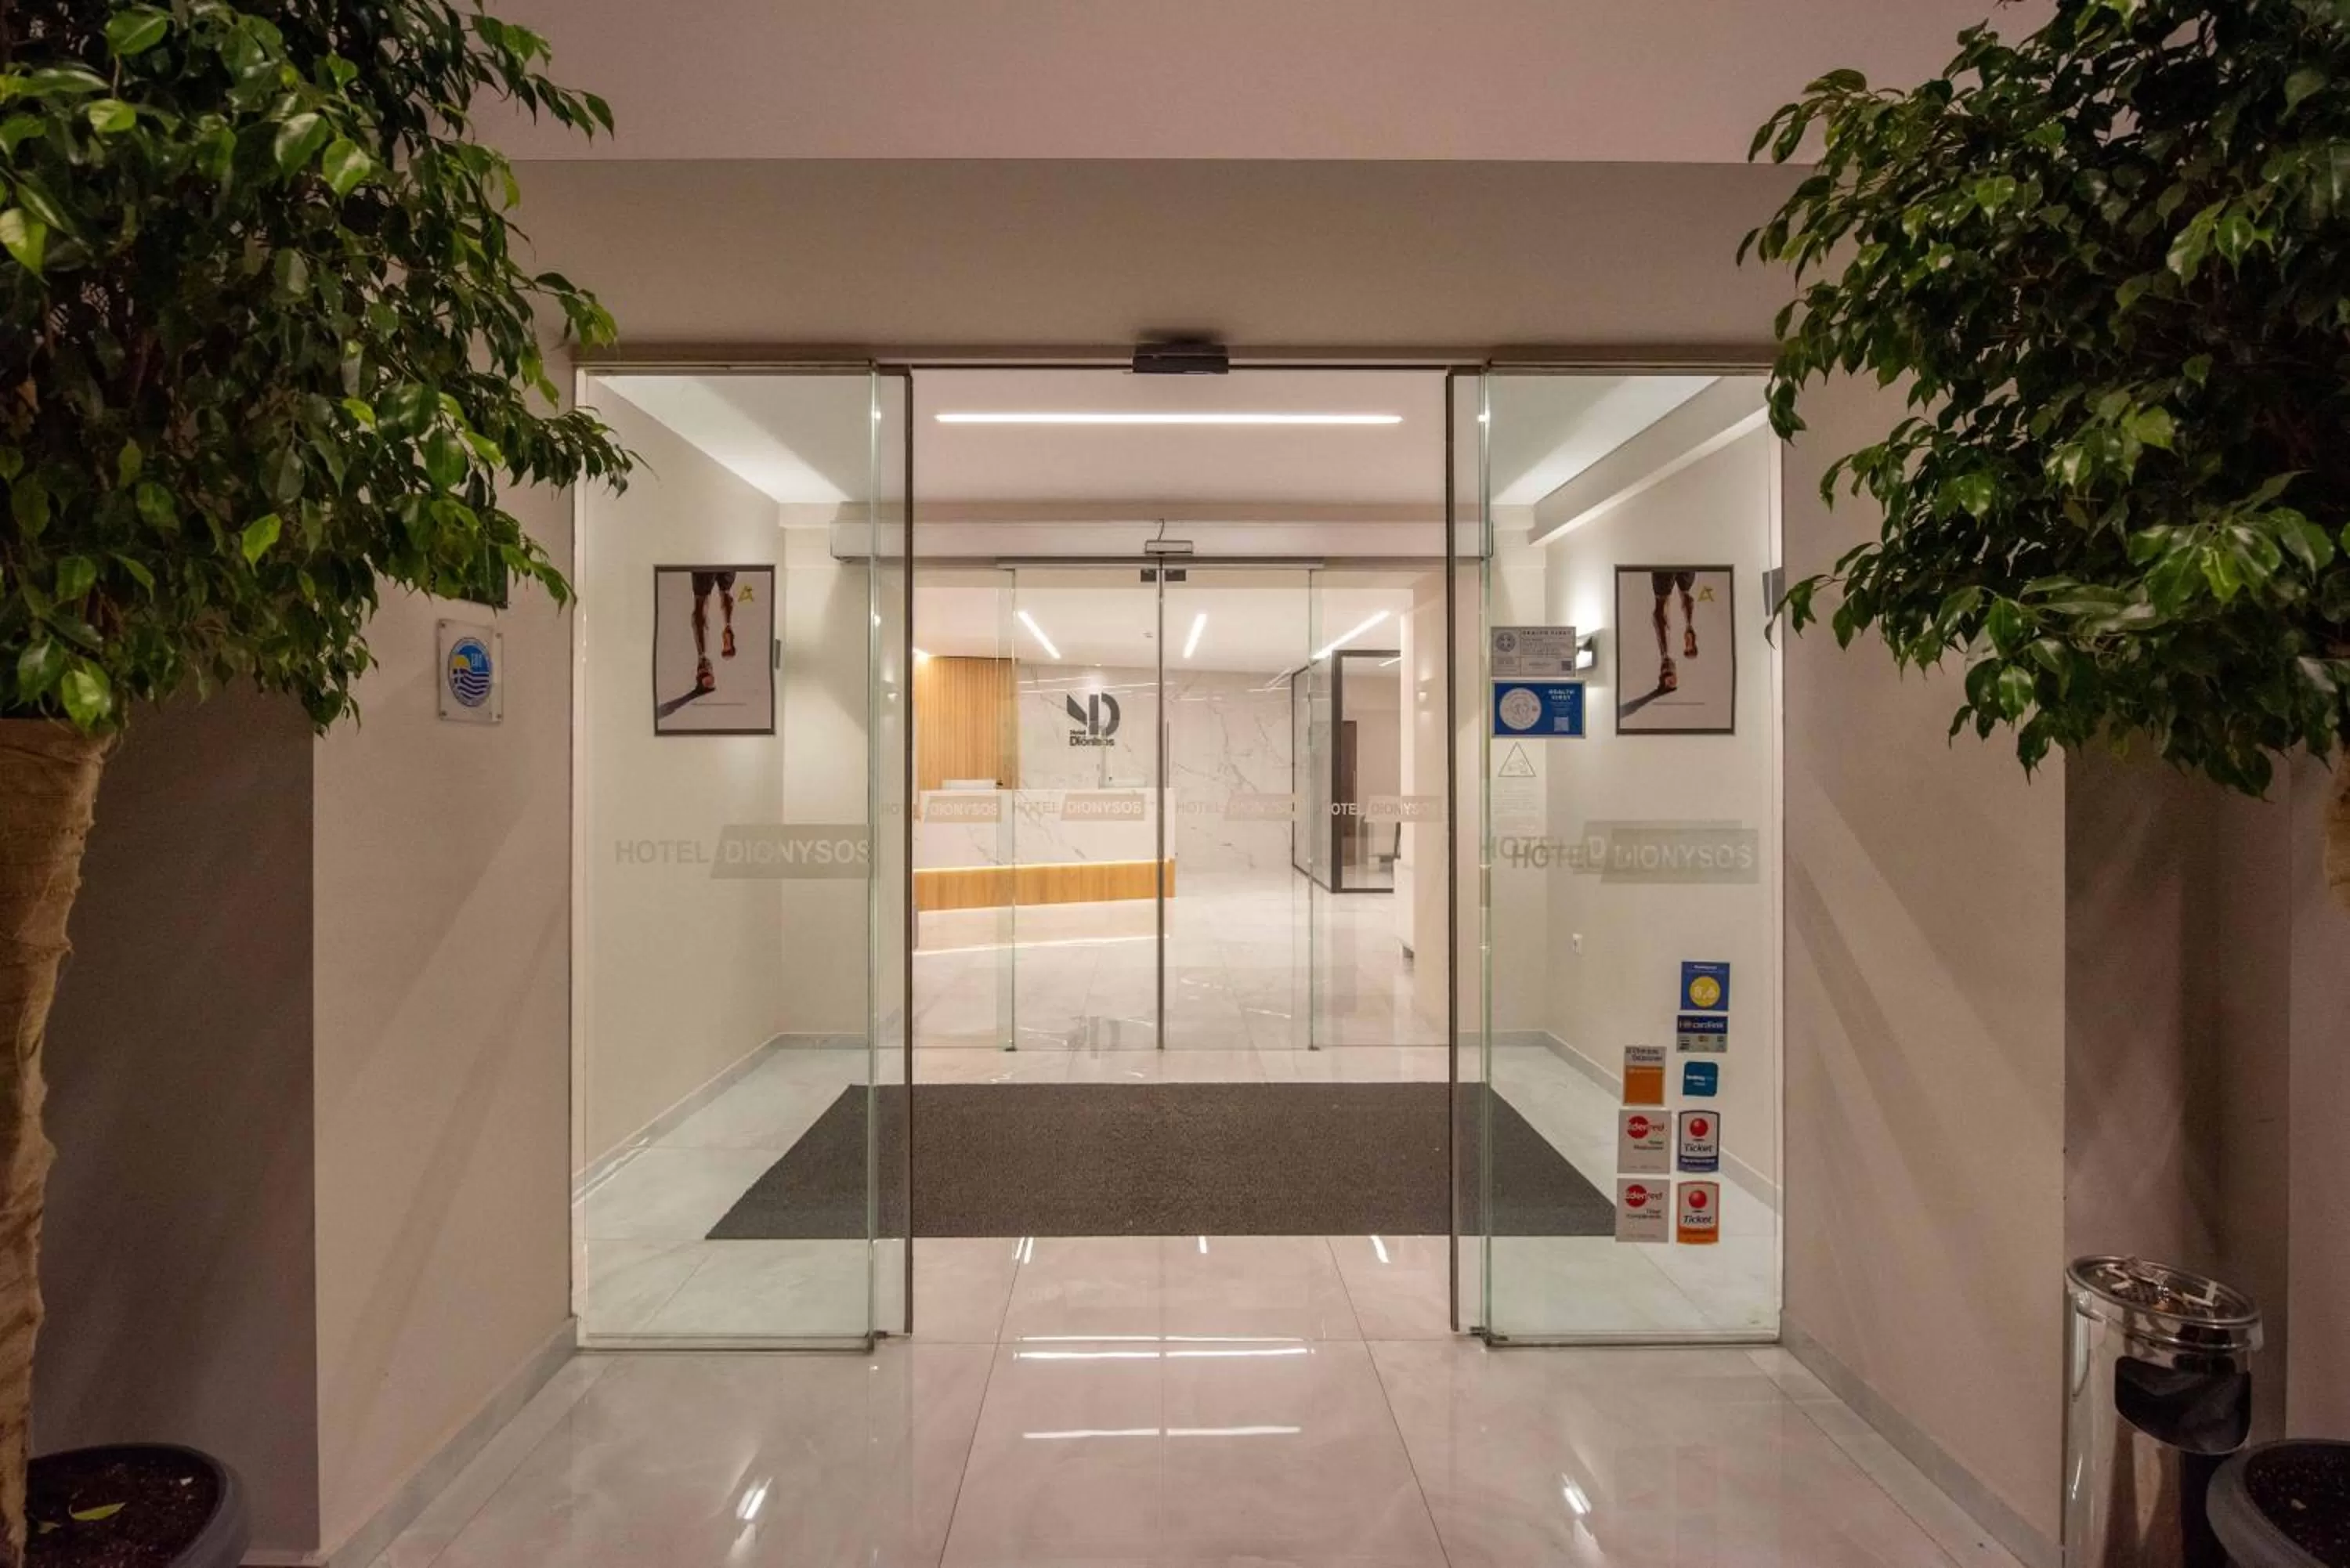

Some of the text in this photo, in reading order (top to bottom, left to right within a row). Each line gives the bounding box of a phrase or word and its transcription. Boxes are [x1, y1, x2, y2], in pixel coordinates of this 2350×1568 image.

[1066, 800, 1142, 815] DIONYSOS
[1332, 802, 1365, 815] OTEL
[615, 838, 870, 864] HOTEL DIONYSOS
[1511, 844, 1605, 869] HOTEL
[1614, 844, 1753, 869] DIONYSOS
